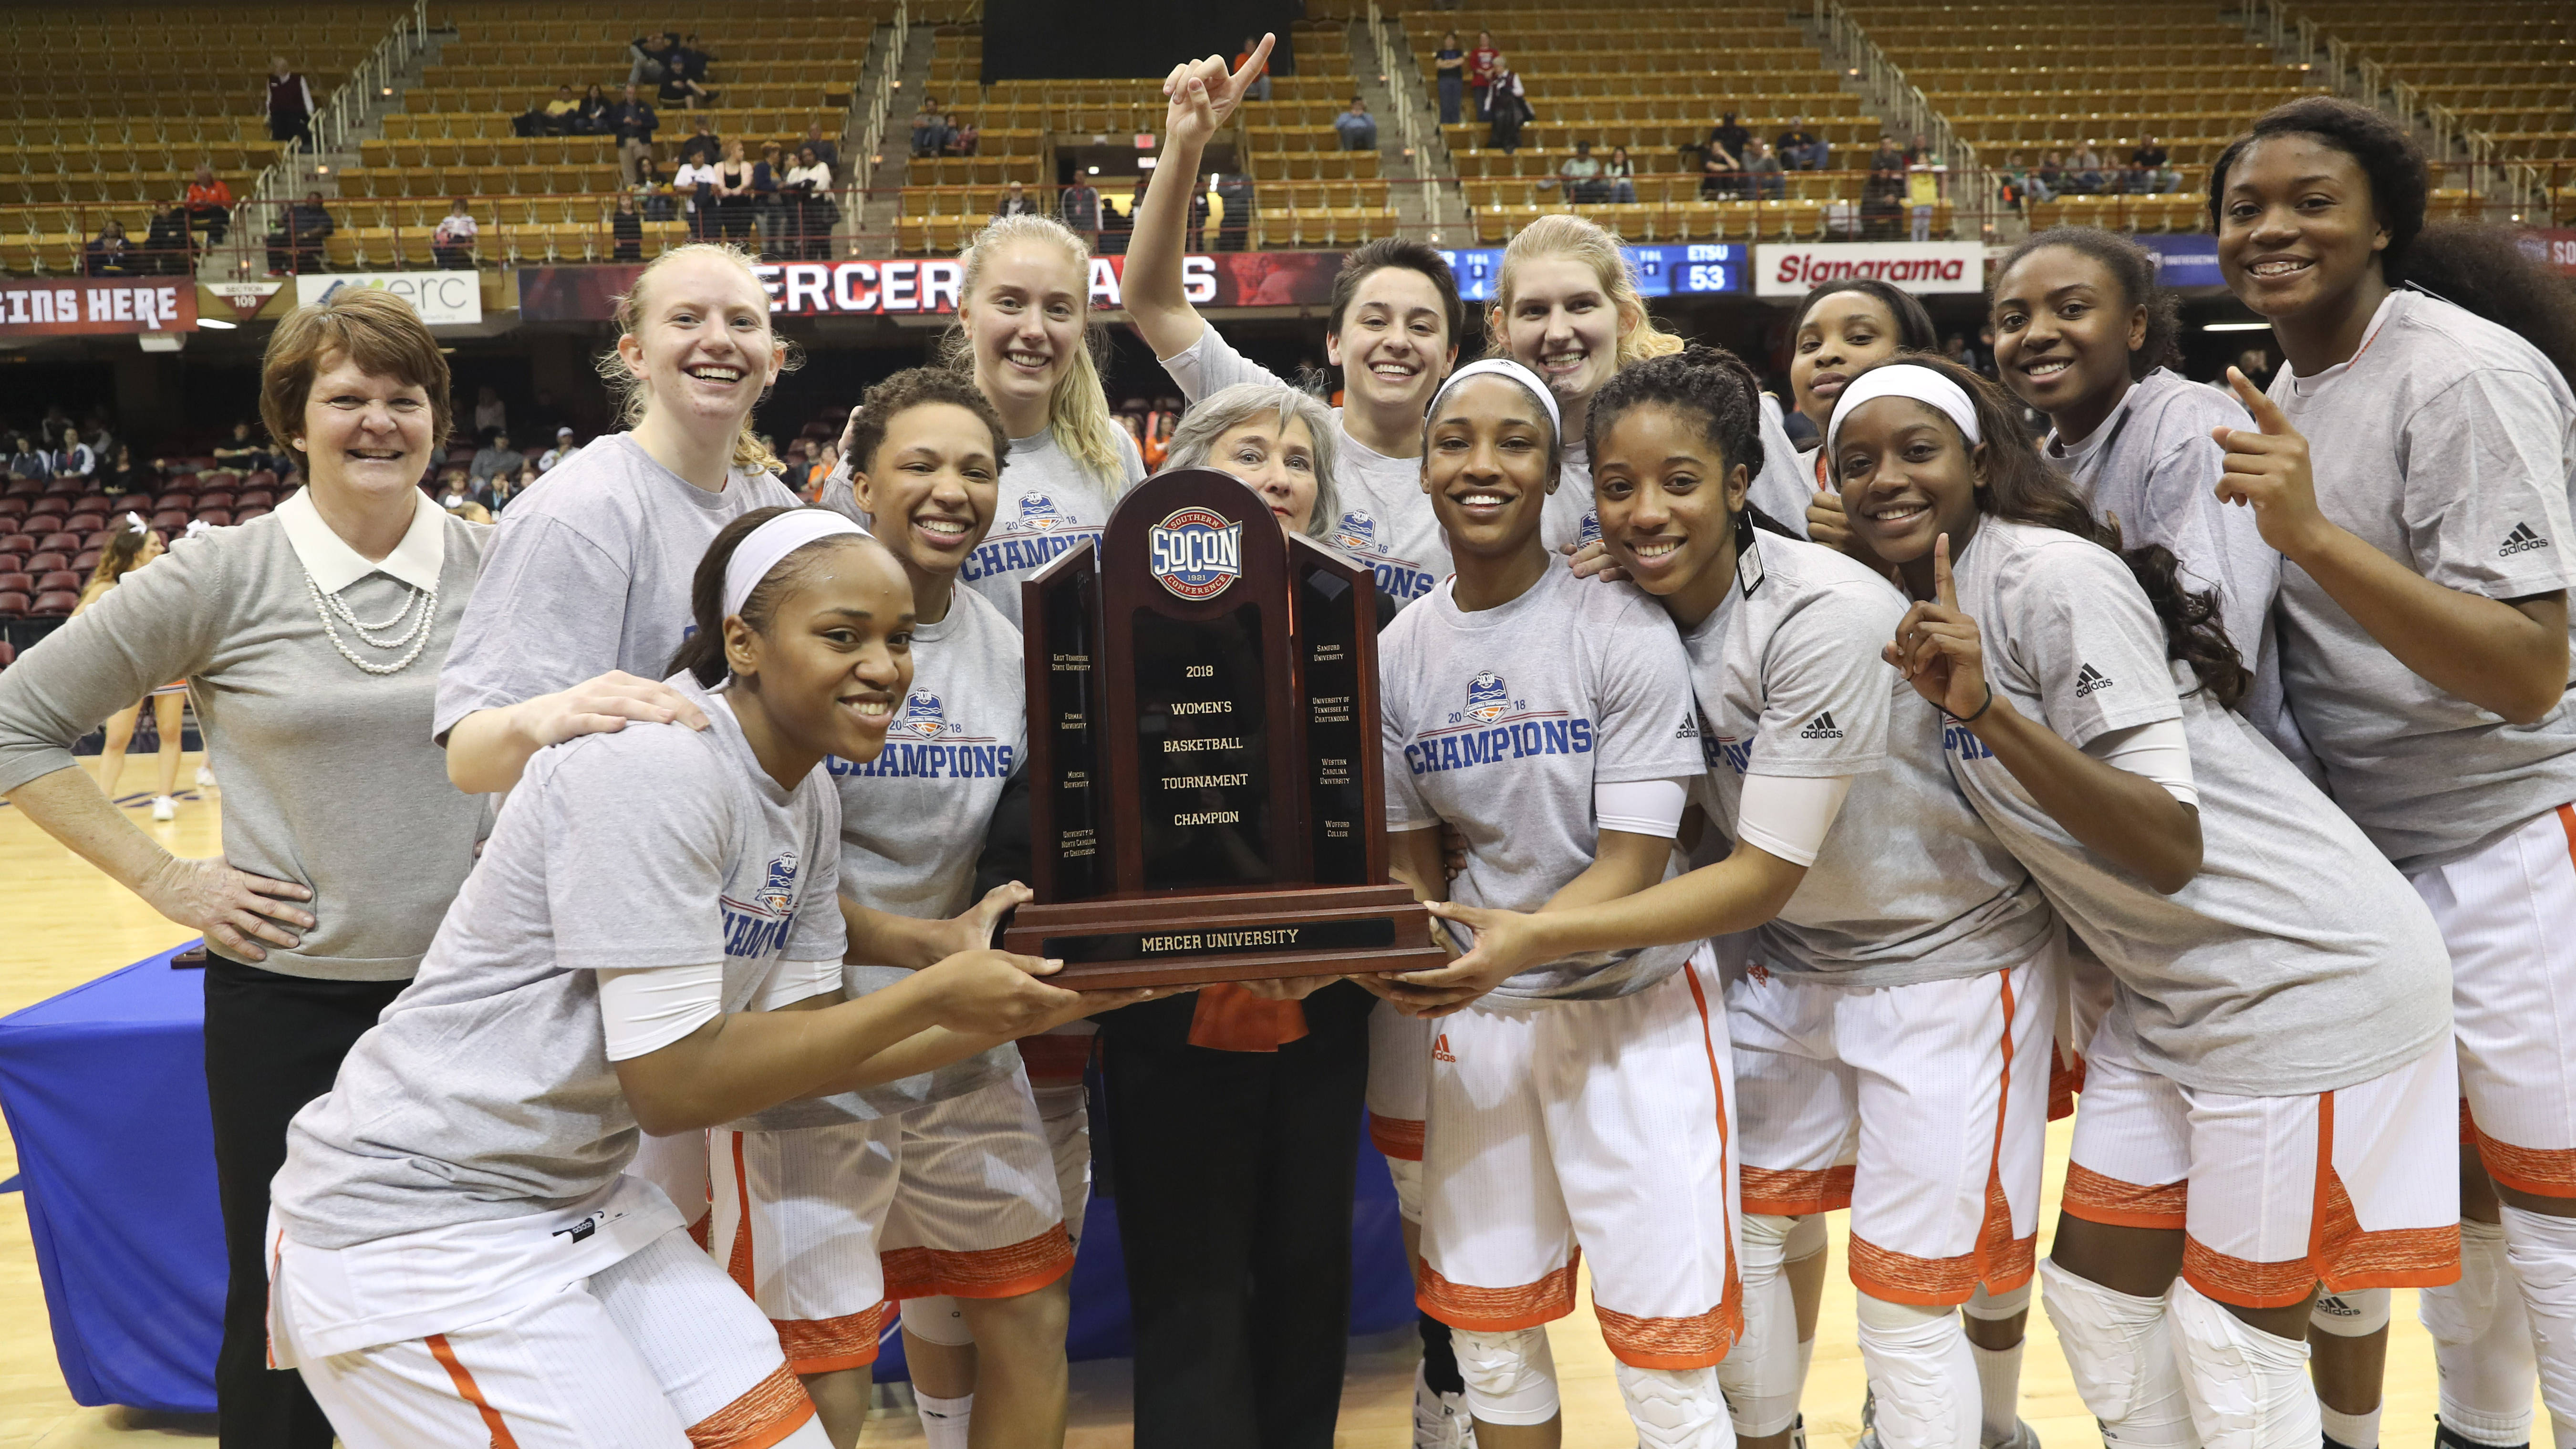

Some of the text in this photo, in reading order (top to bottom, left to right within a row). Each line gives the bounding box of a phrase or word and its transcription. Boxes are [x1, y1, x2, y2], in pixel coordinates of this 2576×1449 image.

[1687, 244, 1728, 261] ETSU
[1689, 265, 1725, 290] 53
[1777, 252, 1964, 289] Signarama
[225, 284, 264, 293] SECTION
[749, 262, 962, 312] ERCER
[0, 287, 178, 330] INS HERE
[233, 295, 257, 308] 109
[1006, 521, 1018, 530] 20
[1066, 516, 1077, 525] 18
[1171, 514, 1219, 528] SOUTHERN
[1153, 527, 1238, 575] SOCON
[1377, 544, 1389, 554] 18
[2498, 538, 2548, 557] adidas
[1167, 575, 1226, 594] CONFERENCE
[1317, 644, 1340, 652] SAMFORD
[1053, 653, 1065, 662] EAST
[1314, 653, 1344, 662] UNIVERSITY
[1186, 665, 1214, 677] 2018
[1476, 673, 1495, 686] SOCON
[2076, 678, 2113, 698] adidas
[1171, 701, 1232, 715] WOMEN'S
[1448, 699, 1526, 724] 20 18
[889, 720, 962, 734] 20 18
[1801, 729, 1843, 739] adidas
[1163, 737, 1243, 752] BASKETBALL
[1404, 718, 1592, 775] CHAMPIONS
[1162, 773, 1248, 790] TOURNAMENT
[1174, 811, 1239, 826] CHAMPION
[1063, 829, 1088, 838] UNIVERSITY
[1076, 838, 1097, 847] CAROLINA
[1070, 848, 1095, 857] GREENSBORO
[1142, 929, 1299, 952] MERCER UNIVERSITY
[573, 1221, 593, 1234] adidas
